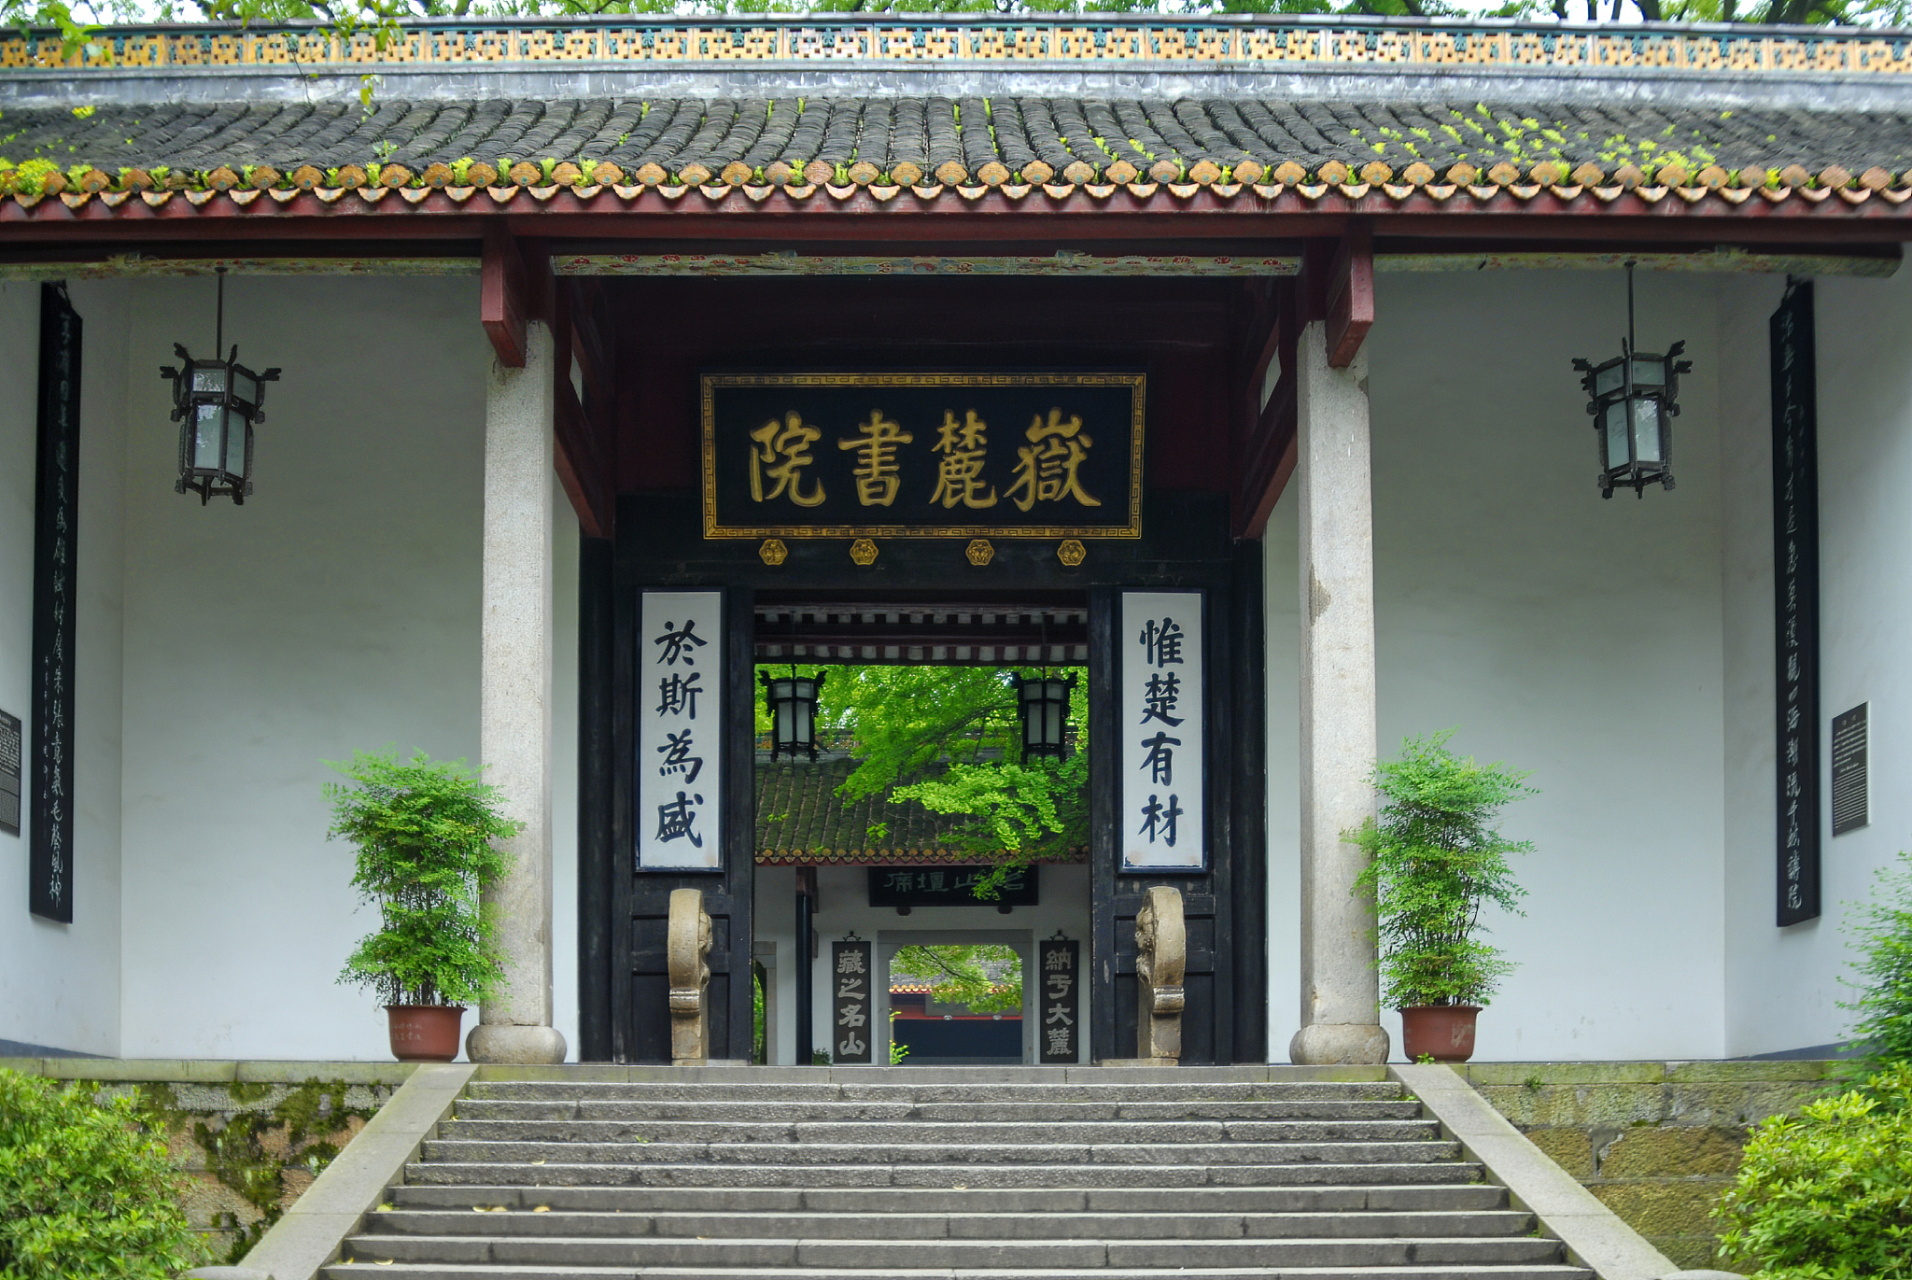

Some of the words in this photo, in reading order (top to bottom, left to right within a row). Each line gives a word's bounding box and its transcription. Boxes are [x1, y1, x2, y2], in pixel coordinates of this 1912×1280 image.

[749, 407, 1101, 512] 嶽麓書院
[654, 619, 708, 848] 於斯為盛
[1138, 616, 1185, 848] 惟楚有材
[836, 949, 866, 1056] 藏之名山
